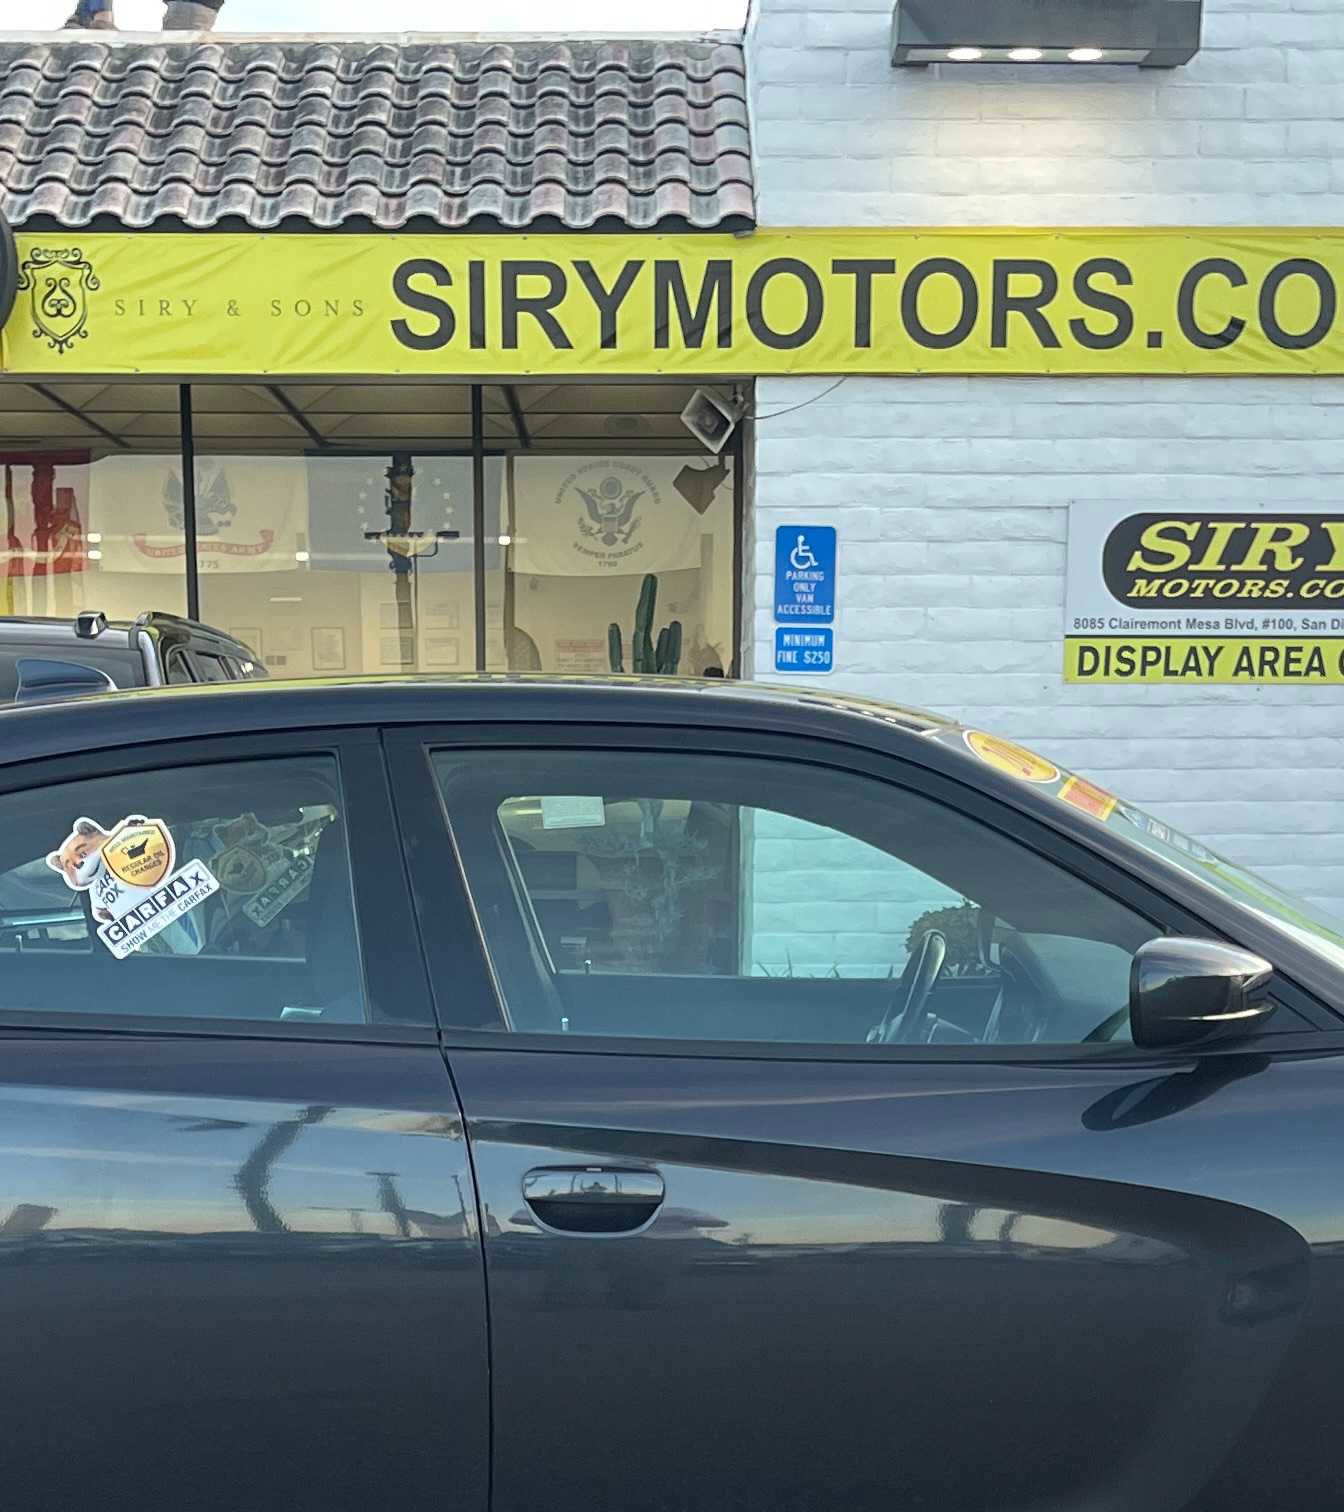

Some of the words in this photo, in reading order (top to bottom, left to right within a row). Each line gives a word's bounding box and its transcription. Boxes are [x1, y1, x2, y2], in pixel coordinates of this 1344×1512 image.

[113, 299, 198, 317] SIRY
[226, 299, 242, 317] &
[270, 299, 365, 318] SONS
[785, 571, 824, 581] PARKING
[793, 582, 816, 592] ONLY
[796, 593, 814, 603] VAN
[777, 604, 832, 615] ACCESSIBLE
[1073, 617, 1105, 630] 8085
[1108, 617, 1182, 630] Clairemont
[1186, 618, 1220, 630] Mesa
[1224, 617, 1258, 632] Blvd,
[1262, 618, 1297, 632] #100,
[1301, 618, 1327, 631] San
[783, 634, 825, 647] MINIMUM
[777, 651, 799, 664] FINE
[803, 651, 831, 664] $250
[1077, 645, 1225, 677] DISPLAY
[1232, 645, 1327, 678] AREA
[104, 871, 205, 945] CARFAX
[120, 930, 148, 953] SHOW
[177, 883, 213, 912] CARFAX
